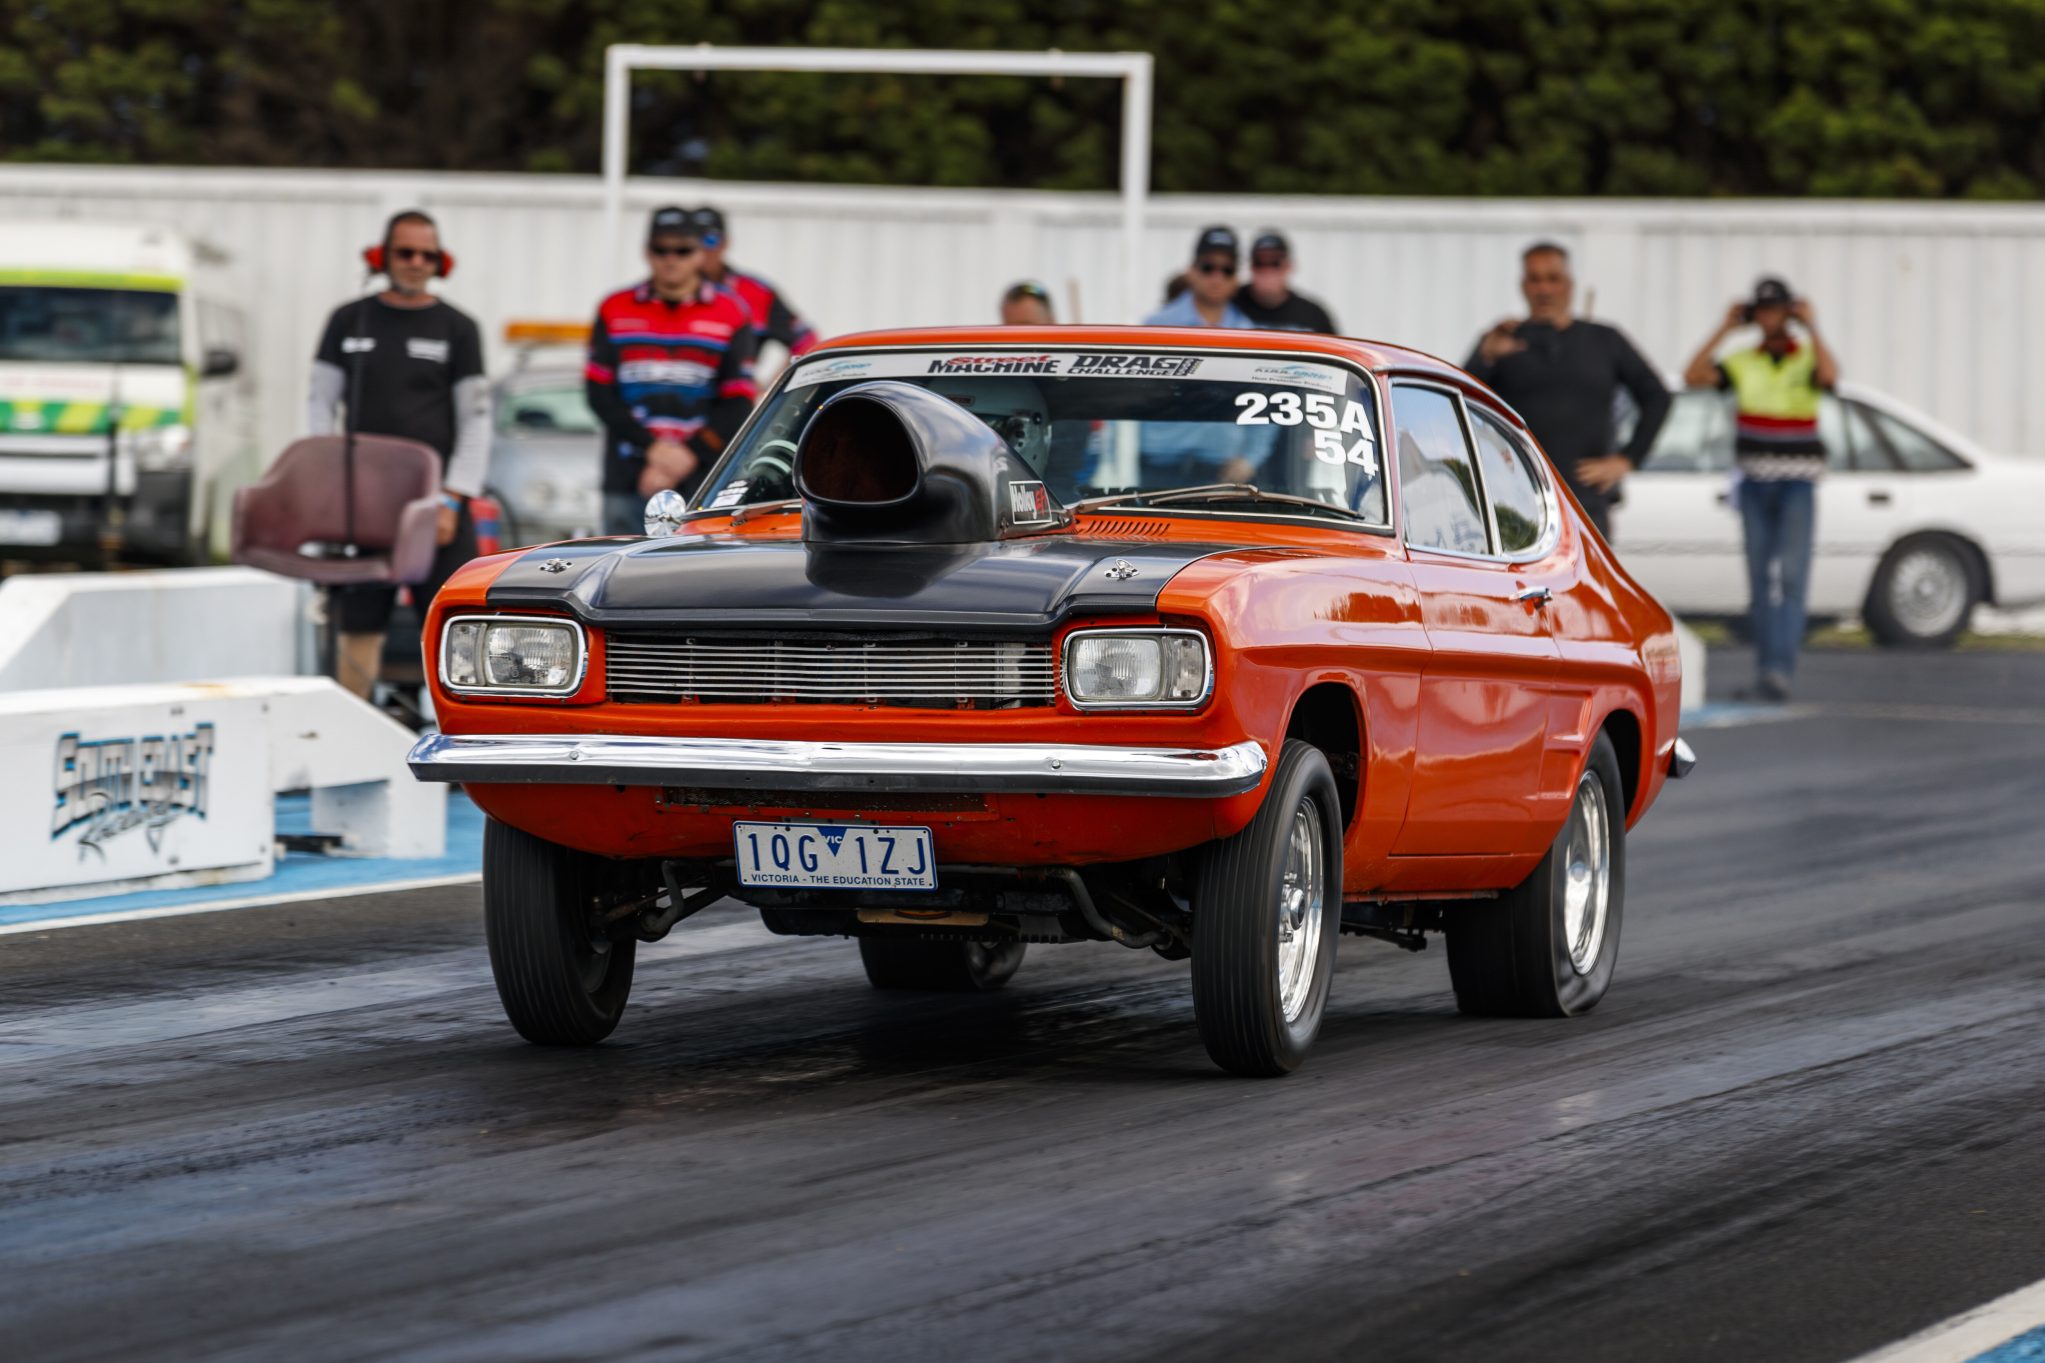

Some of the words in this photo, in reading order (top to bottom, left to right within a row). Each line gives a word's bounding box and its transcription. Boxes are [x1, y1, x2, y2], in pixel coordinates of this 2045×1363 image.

[927, 360, 1061, 374] MACHINE
[1066, 367, 1175, 377] CHALLENGE
[1072, 355, 1184, 370] DRAG
[1235, 392, 1375, 441] 235A
[1314, 429, 1379, 476] 54
[1010, 484, 1037, 520] Holley
[748, 833, 819, 873] 1QG
[855, 836, 926, 875] 1ZJ
[751, 874, 800, 883] VICTORIA
[810, 875, 830, 884] THE
[833, 876, 892, 885] EDUCATION
[894, 877, 926, 886] STATE
